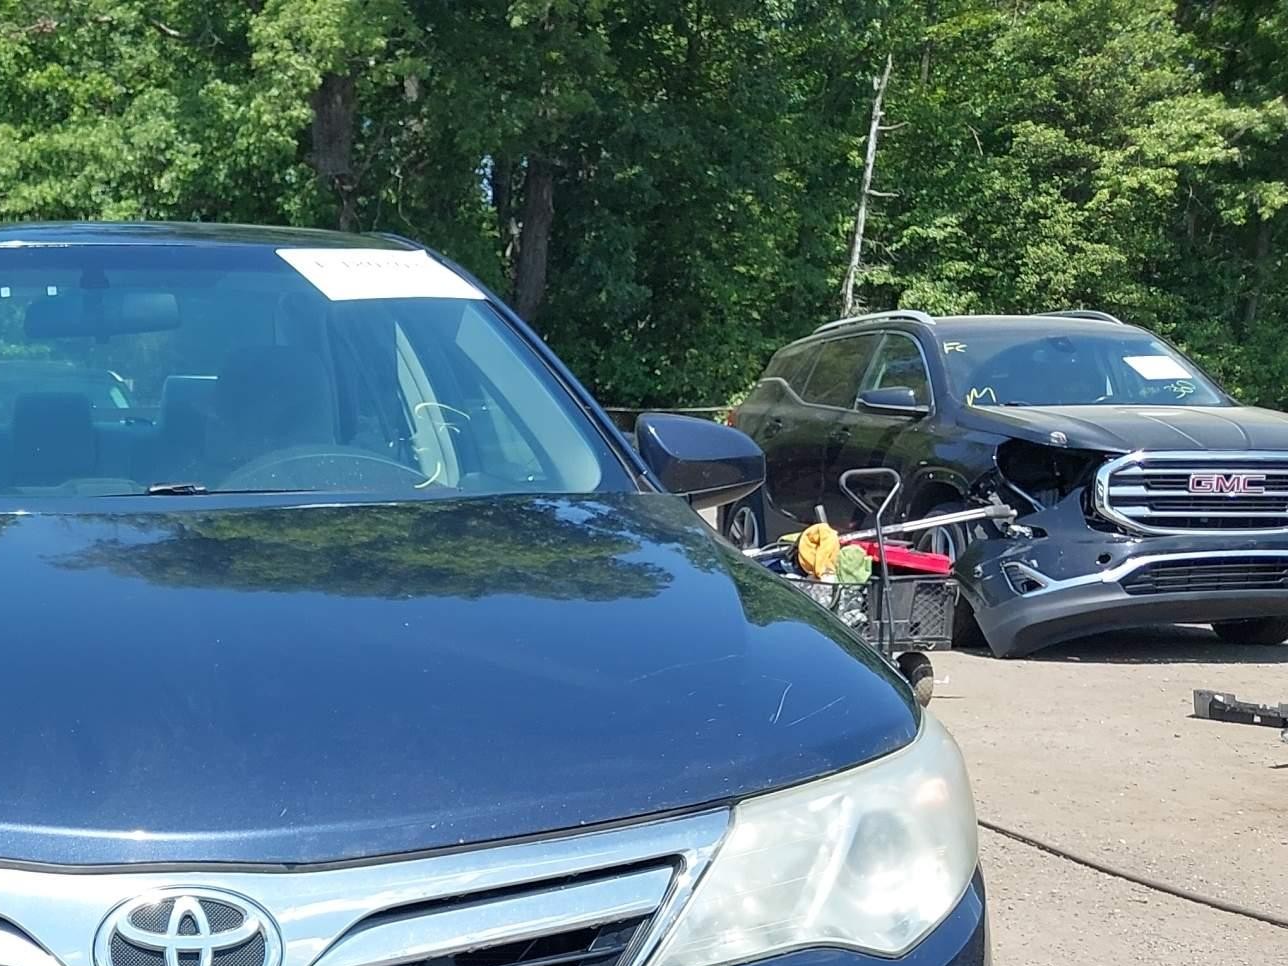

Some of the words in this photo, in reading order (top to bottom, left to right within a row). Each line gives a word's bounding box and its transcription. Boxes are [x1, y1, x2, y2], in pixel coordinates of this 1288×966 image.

[943, 342, 968, 354] FC
[966, 387, 997, 407] M
[1189, 474, 1267, 493] GMC
